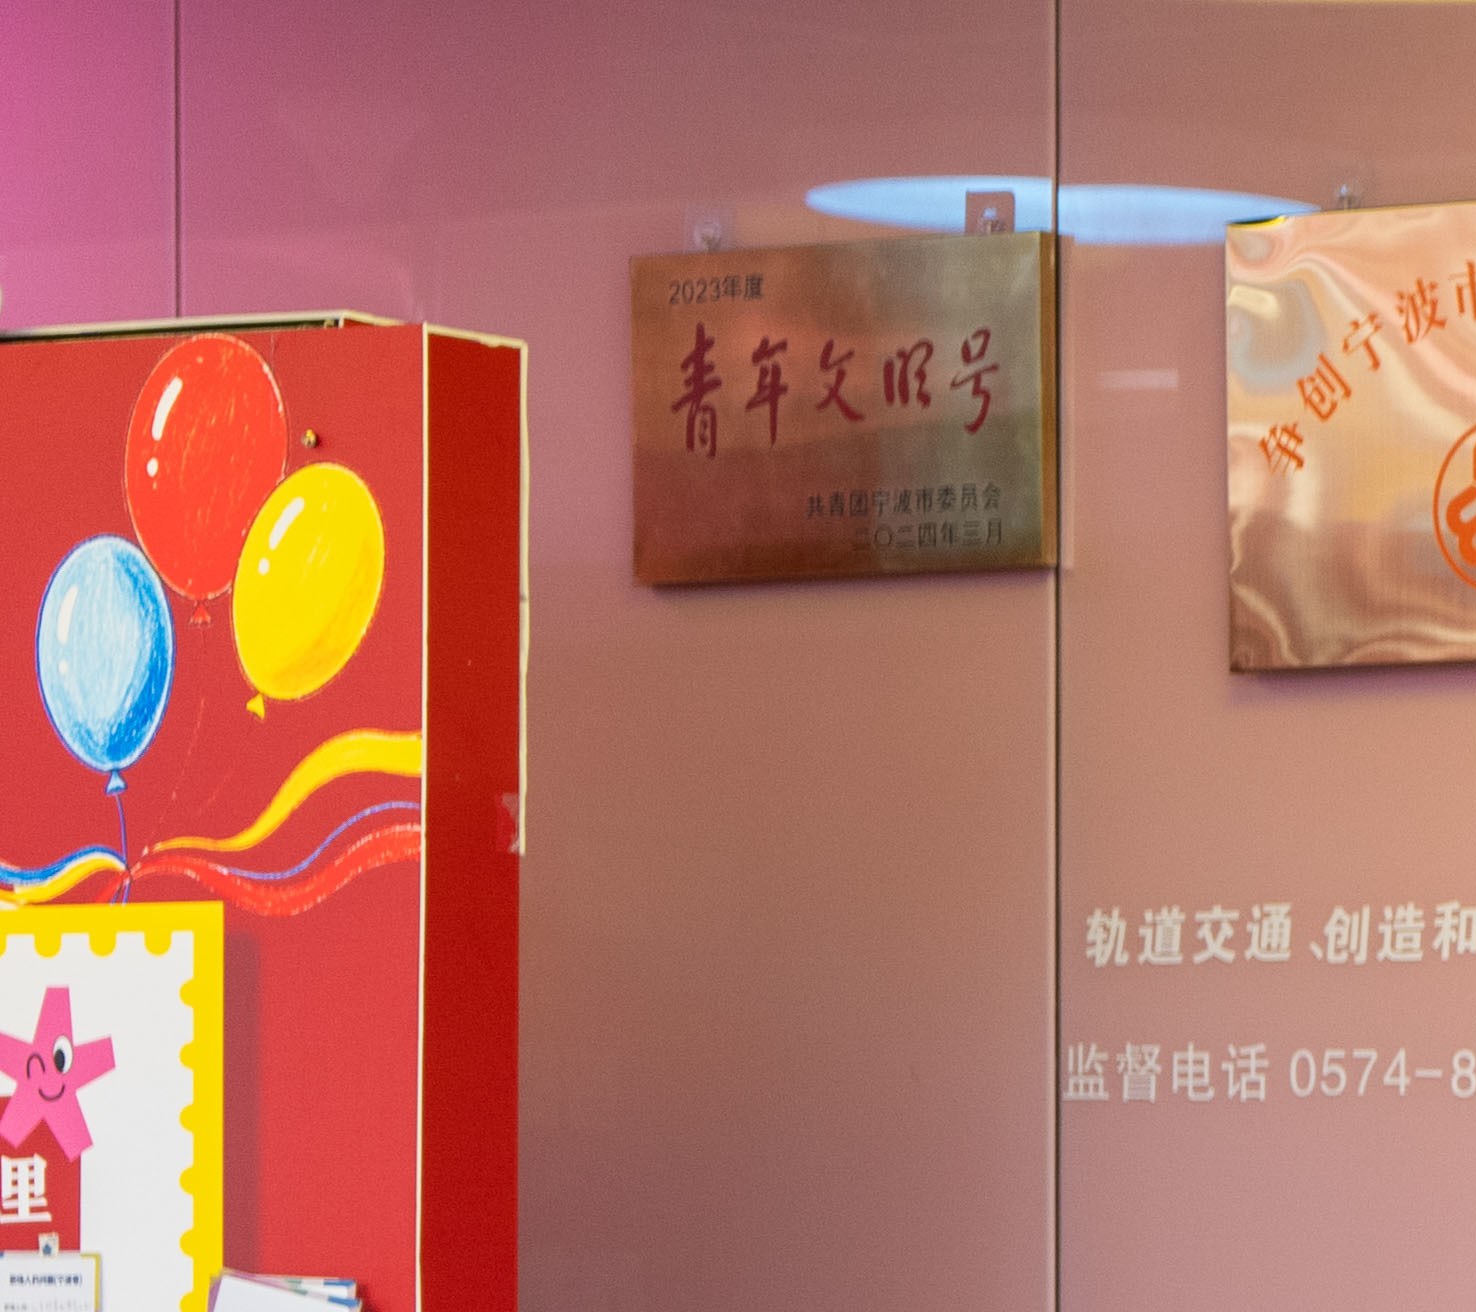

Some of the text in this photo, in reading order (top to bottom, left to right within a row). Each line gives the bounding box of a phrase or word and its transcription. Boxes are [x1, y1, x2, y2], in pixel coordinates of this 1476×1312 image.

[669, 274, 763, 304] 2023年度
[1063, 1042, 1268, 1101] 监督电话
[0, 1152, 52, 1224] 里
